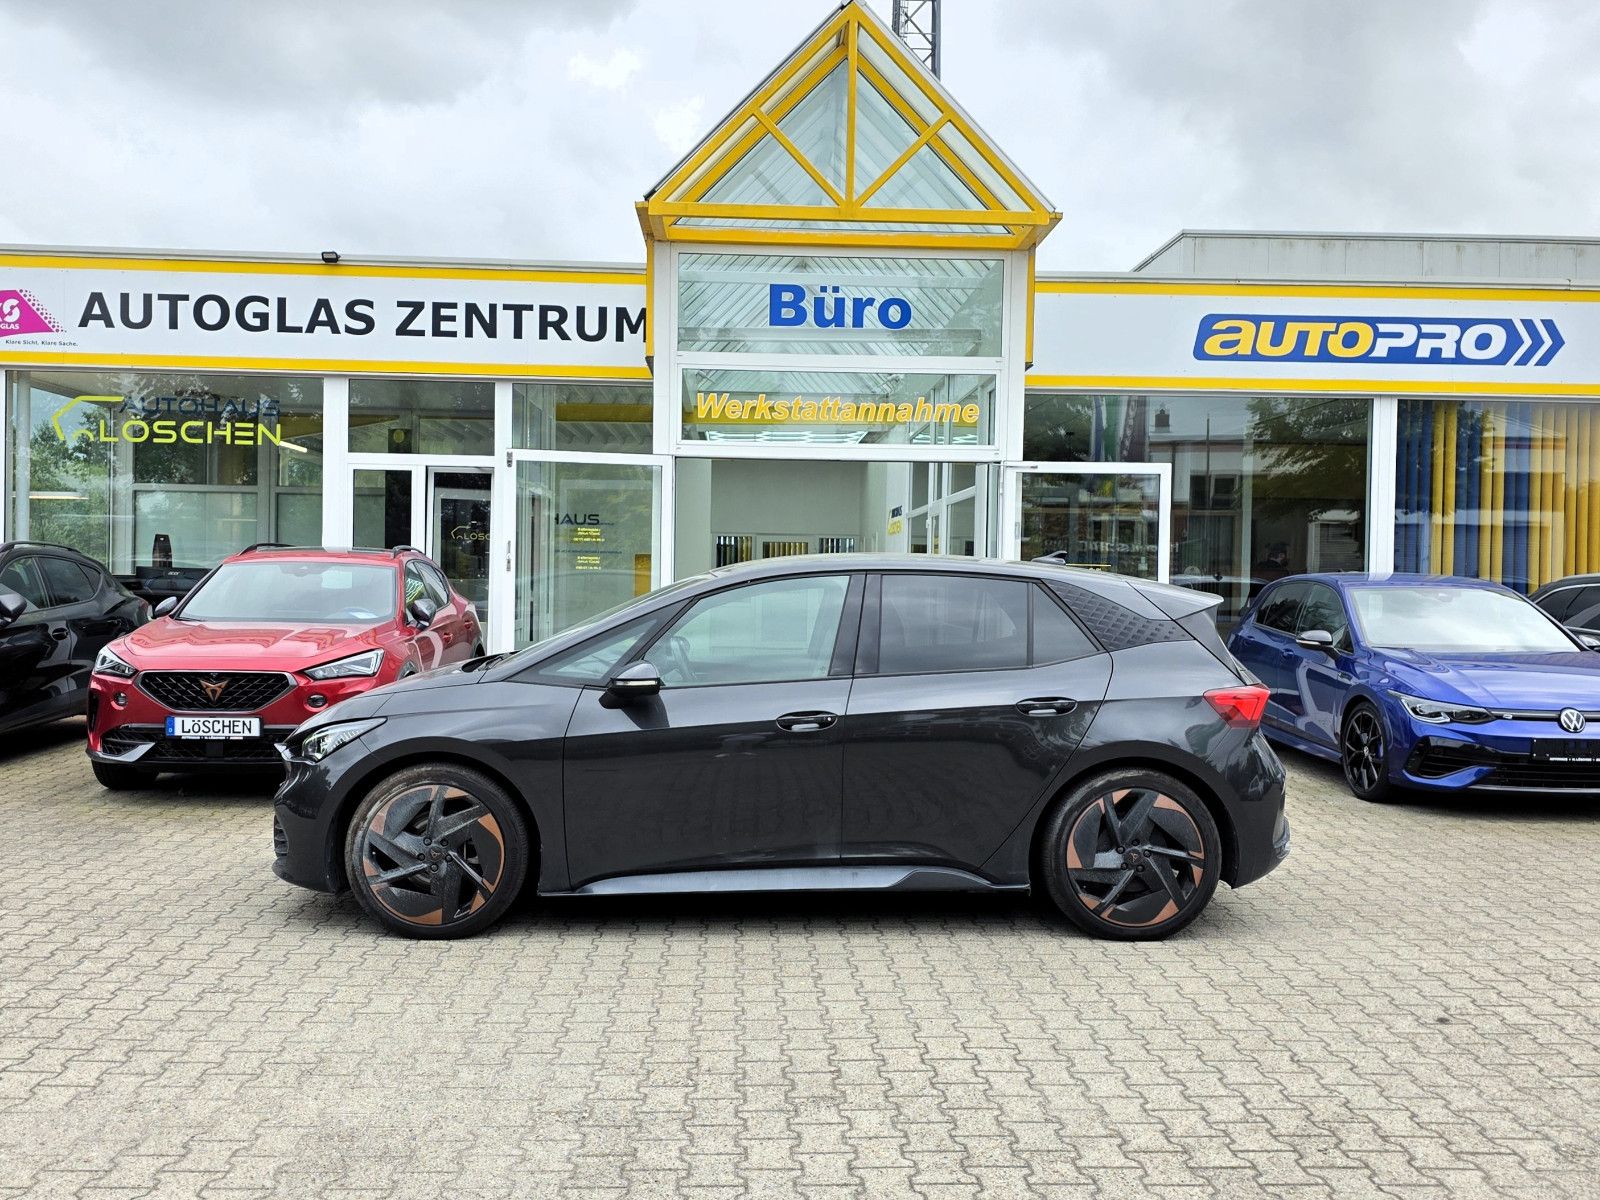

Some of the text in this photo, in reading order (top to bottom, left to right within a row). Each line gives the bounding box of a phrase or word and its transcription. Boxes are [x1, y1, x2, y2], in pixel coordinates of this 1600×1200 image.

[78, 290, 646, 343] AUTOGLAS ZENTRUM
[768, 283, 912, 330] Büro
[118, 396, 281, 417] AUTOHAUS
[696, 392, 980, 424] Werkstattannahme
[100, 415, 282, 447] LÖSCHEN
